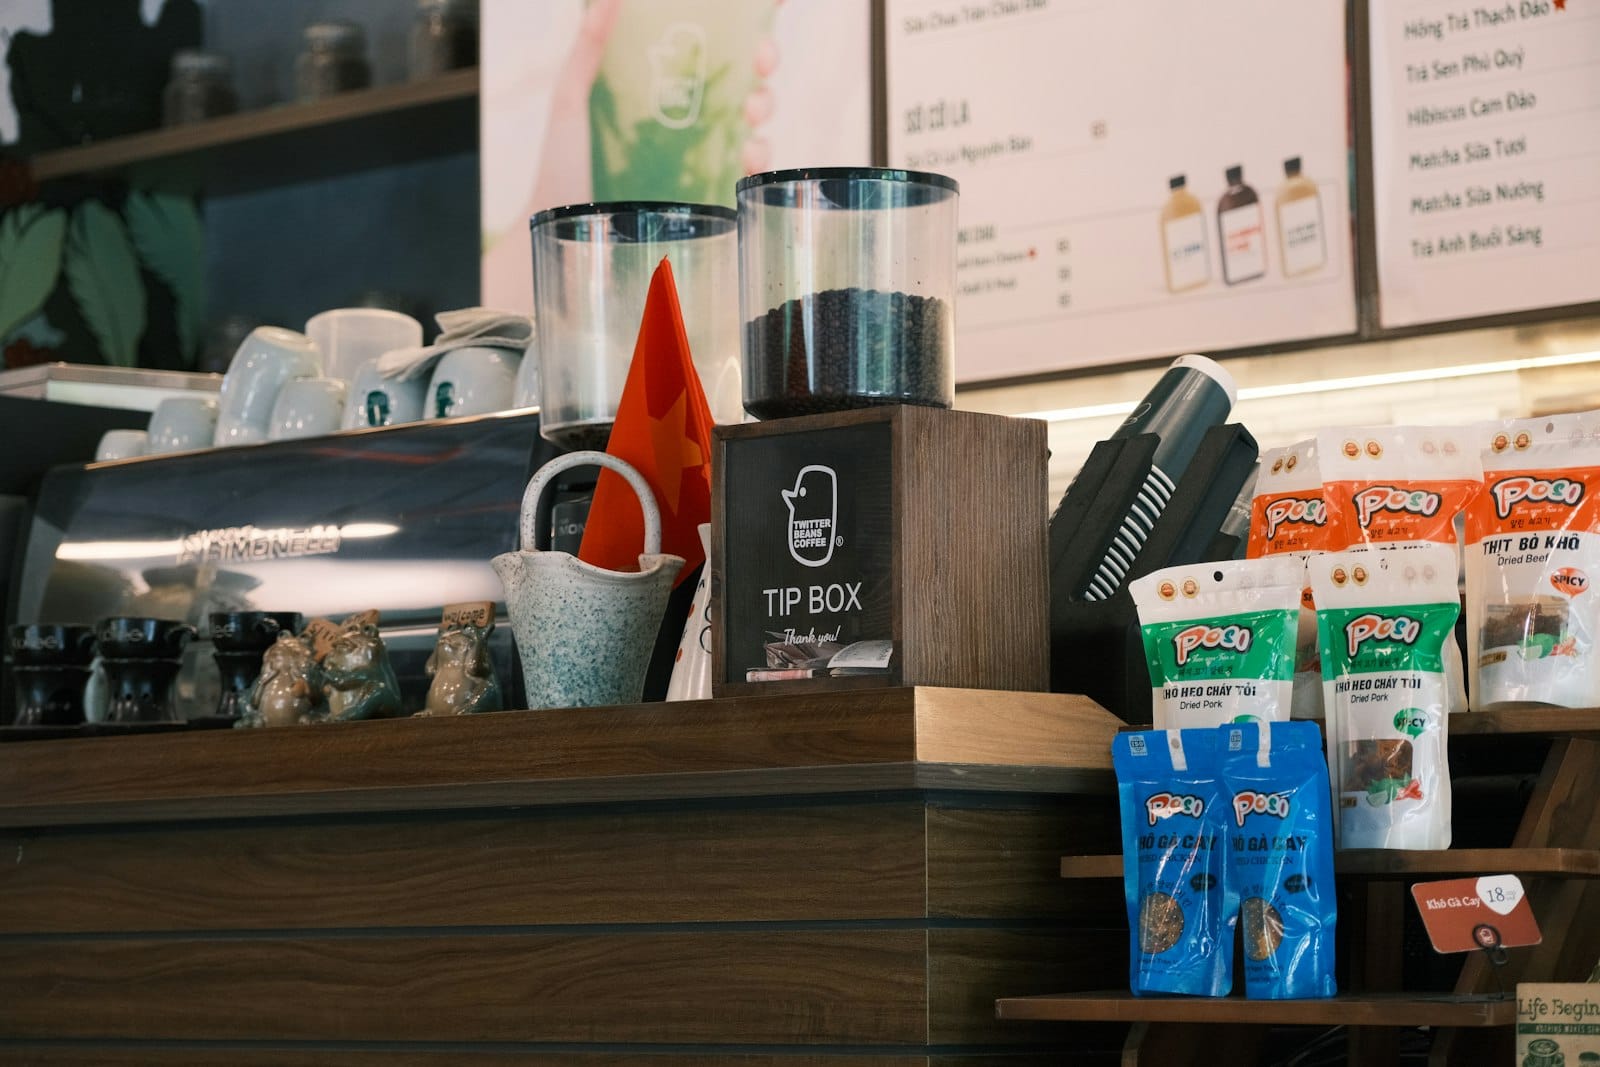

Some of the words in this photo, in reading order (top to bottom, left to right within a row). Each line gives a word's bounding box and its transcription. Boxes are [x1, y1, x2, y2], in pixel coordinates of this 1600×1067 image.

[1470, 97, 1502, 117] Cam
[1409, 149, 1460, 170] Matcha
[1410, 191, 1462, 213] Matcha
[793, 519, 831, 529] TWITTER
[794, 529, 823, 538] BEANS
[794, 537, 827, 549] COFFEE
[1545, 533, 1580, 551] KHÔ
[1497, 554, 1523, 566] Dried
[1526, 553, 1550, 564] Beef
[1554, 575, 1585, 587] SPICY
[763, 587, 801, 617] TIP
[809, 582, 862, 614] BOX
[783, 627, 816, 646] Thank
[818, 625, 841, 647] you!
[1352, 679, 1372, 691] HEO
[1163, 685, 1178, 700] HÔ
[1181, 686, 1204, 697] HEO
[1350, 694, 1369, 704] Dried
[1371, 693, 1389, 702] Pork
[1180, 701, 1201, 710] Dried
[1203, 700, 1223, 709] Pork
[1487, 887, 1505, 903] 18
[1426, 898, 1447, 910] Khô
[1447, 897, 1462, 908] Gà
[1462, 896, 1480, 908] Cay
[1518, 997, 1548, 1021] Life
